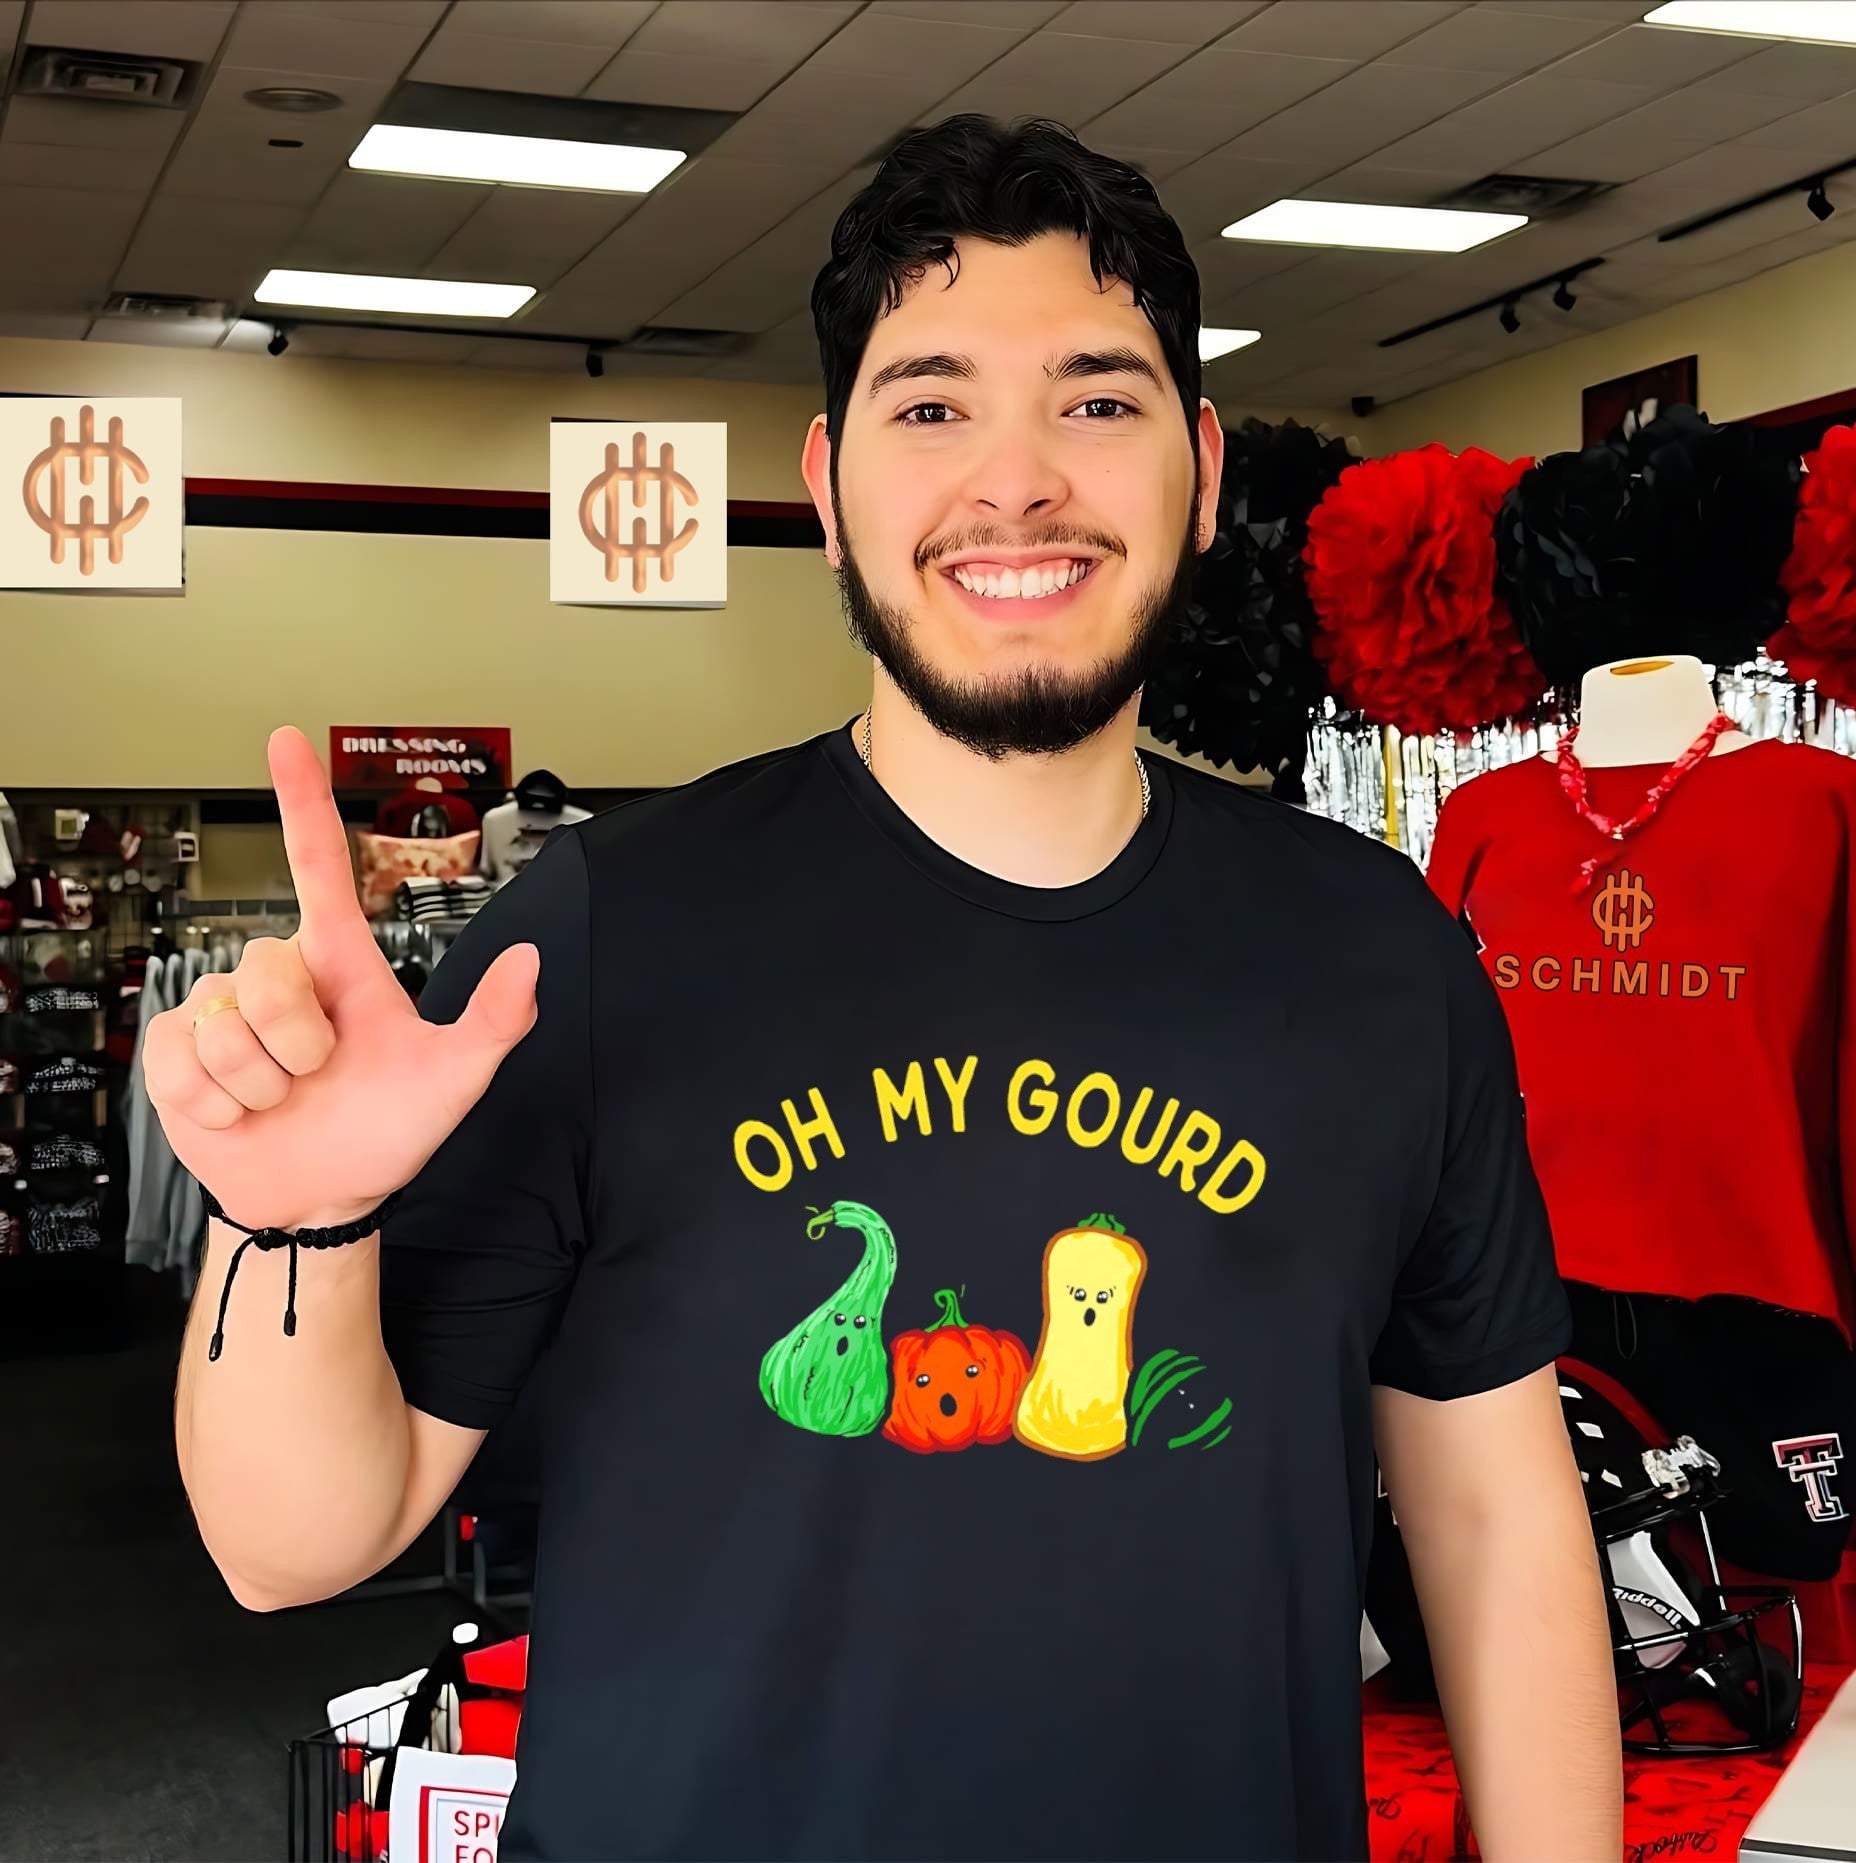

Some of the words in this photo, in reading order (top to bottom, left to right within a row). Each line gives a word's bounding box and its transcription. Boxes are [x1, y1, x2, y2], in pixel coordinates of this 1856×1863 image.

[1494, 954, 1746, 1000] SCHMIDT
[734, 1087, 845, 1192] OH
[872, 1055, 978, 1142] MY
[1007, 1059, 1266, 1214] GOURD
